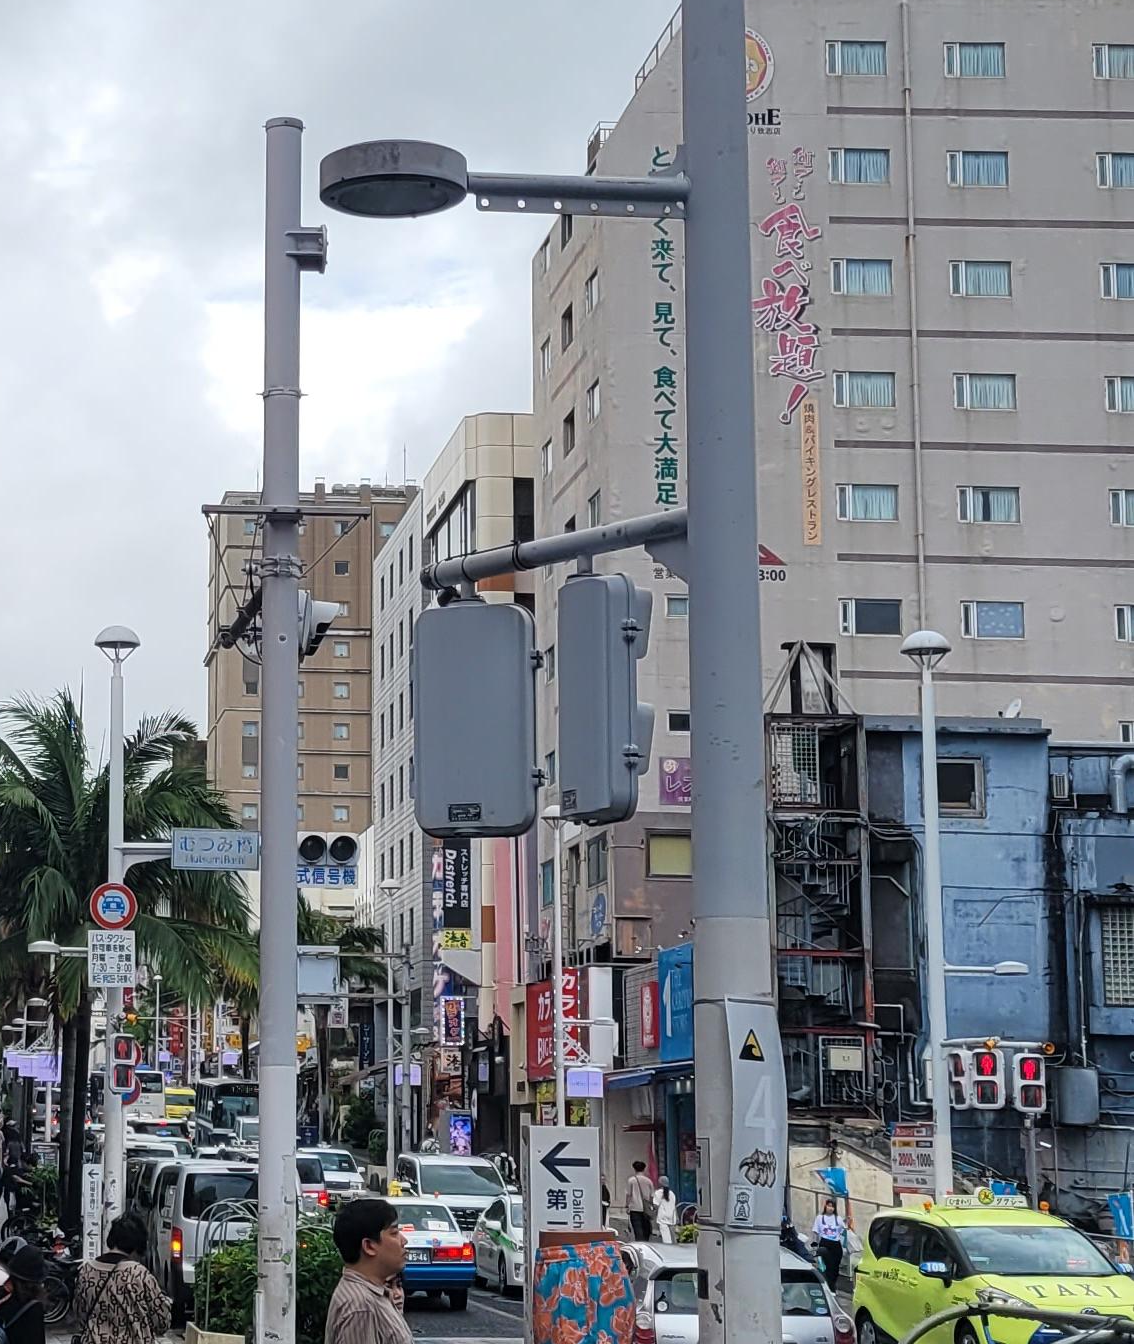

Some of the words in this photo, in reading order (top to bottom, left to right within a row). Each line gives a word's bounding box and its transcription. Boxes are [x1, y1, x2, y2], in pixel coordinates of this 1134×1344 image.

[179, 835, 253, 854] むつみ橋
[1025, 1282, 1123, 1299] TAXI
